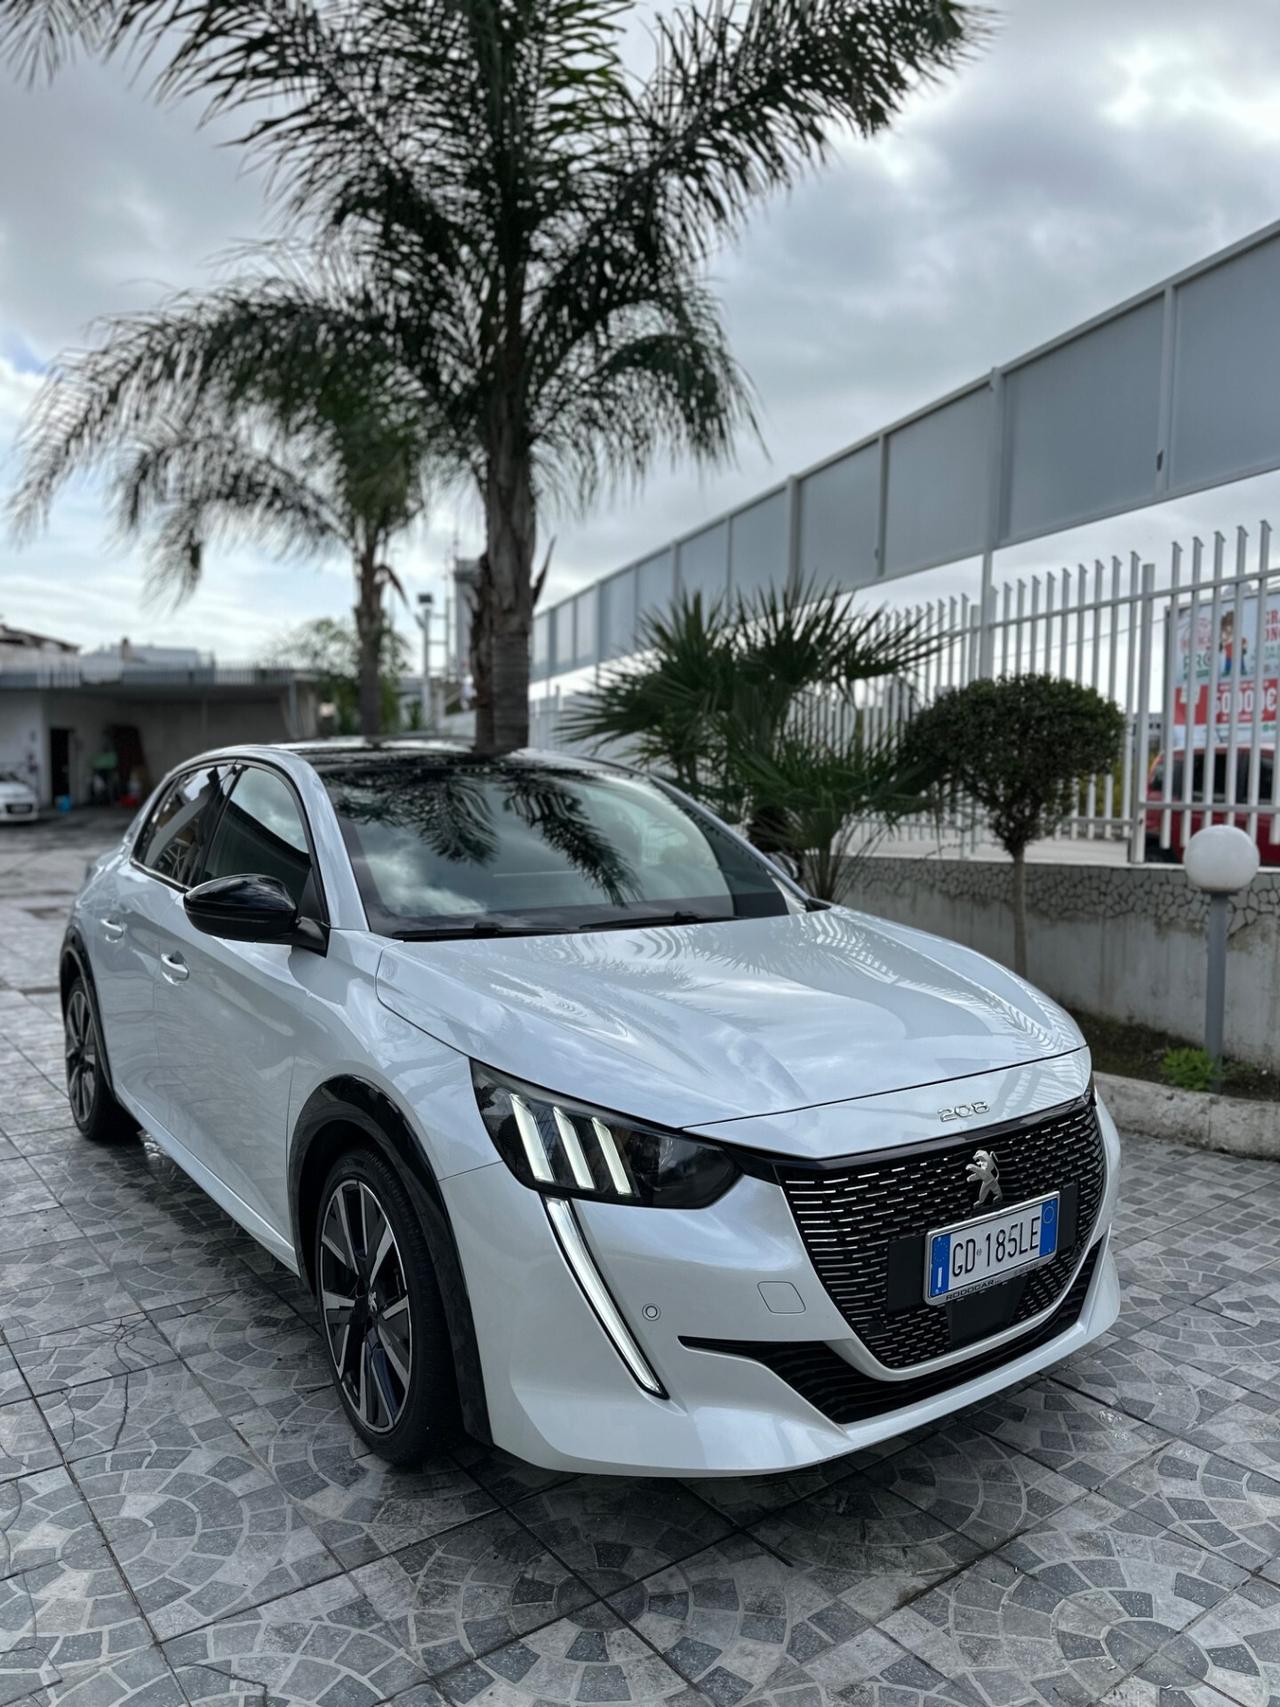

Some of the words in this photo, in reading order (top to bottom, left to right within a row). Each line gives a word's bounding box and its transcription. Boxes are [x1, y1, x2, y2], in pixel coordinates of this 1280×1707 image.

[937, 1101, 990, 1123] 208
[952, 1238, 976, 1278] GD
[985, 1216, 1041, 1267] 185LE
